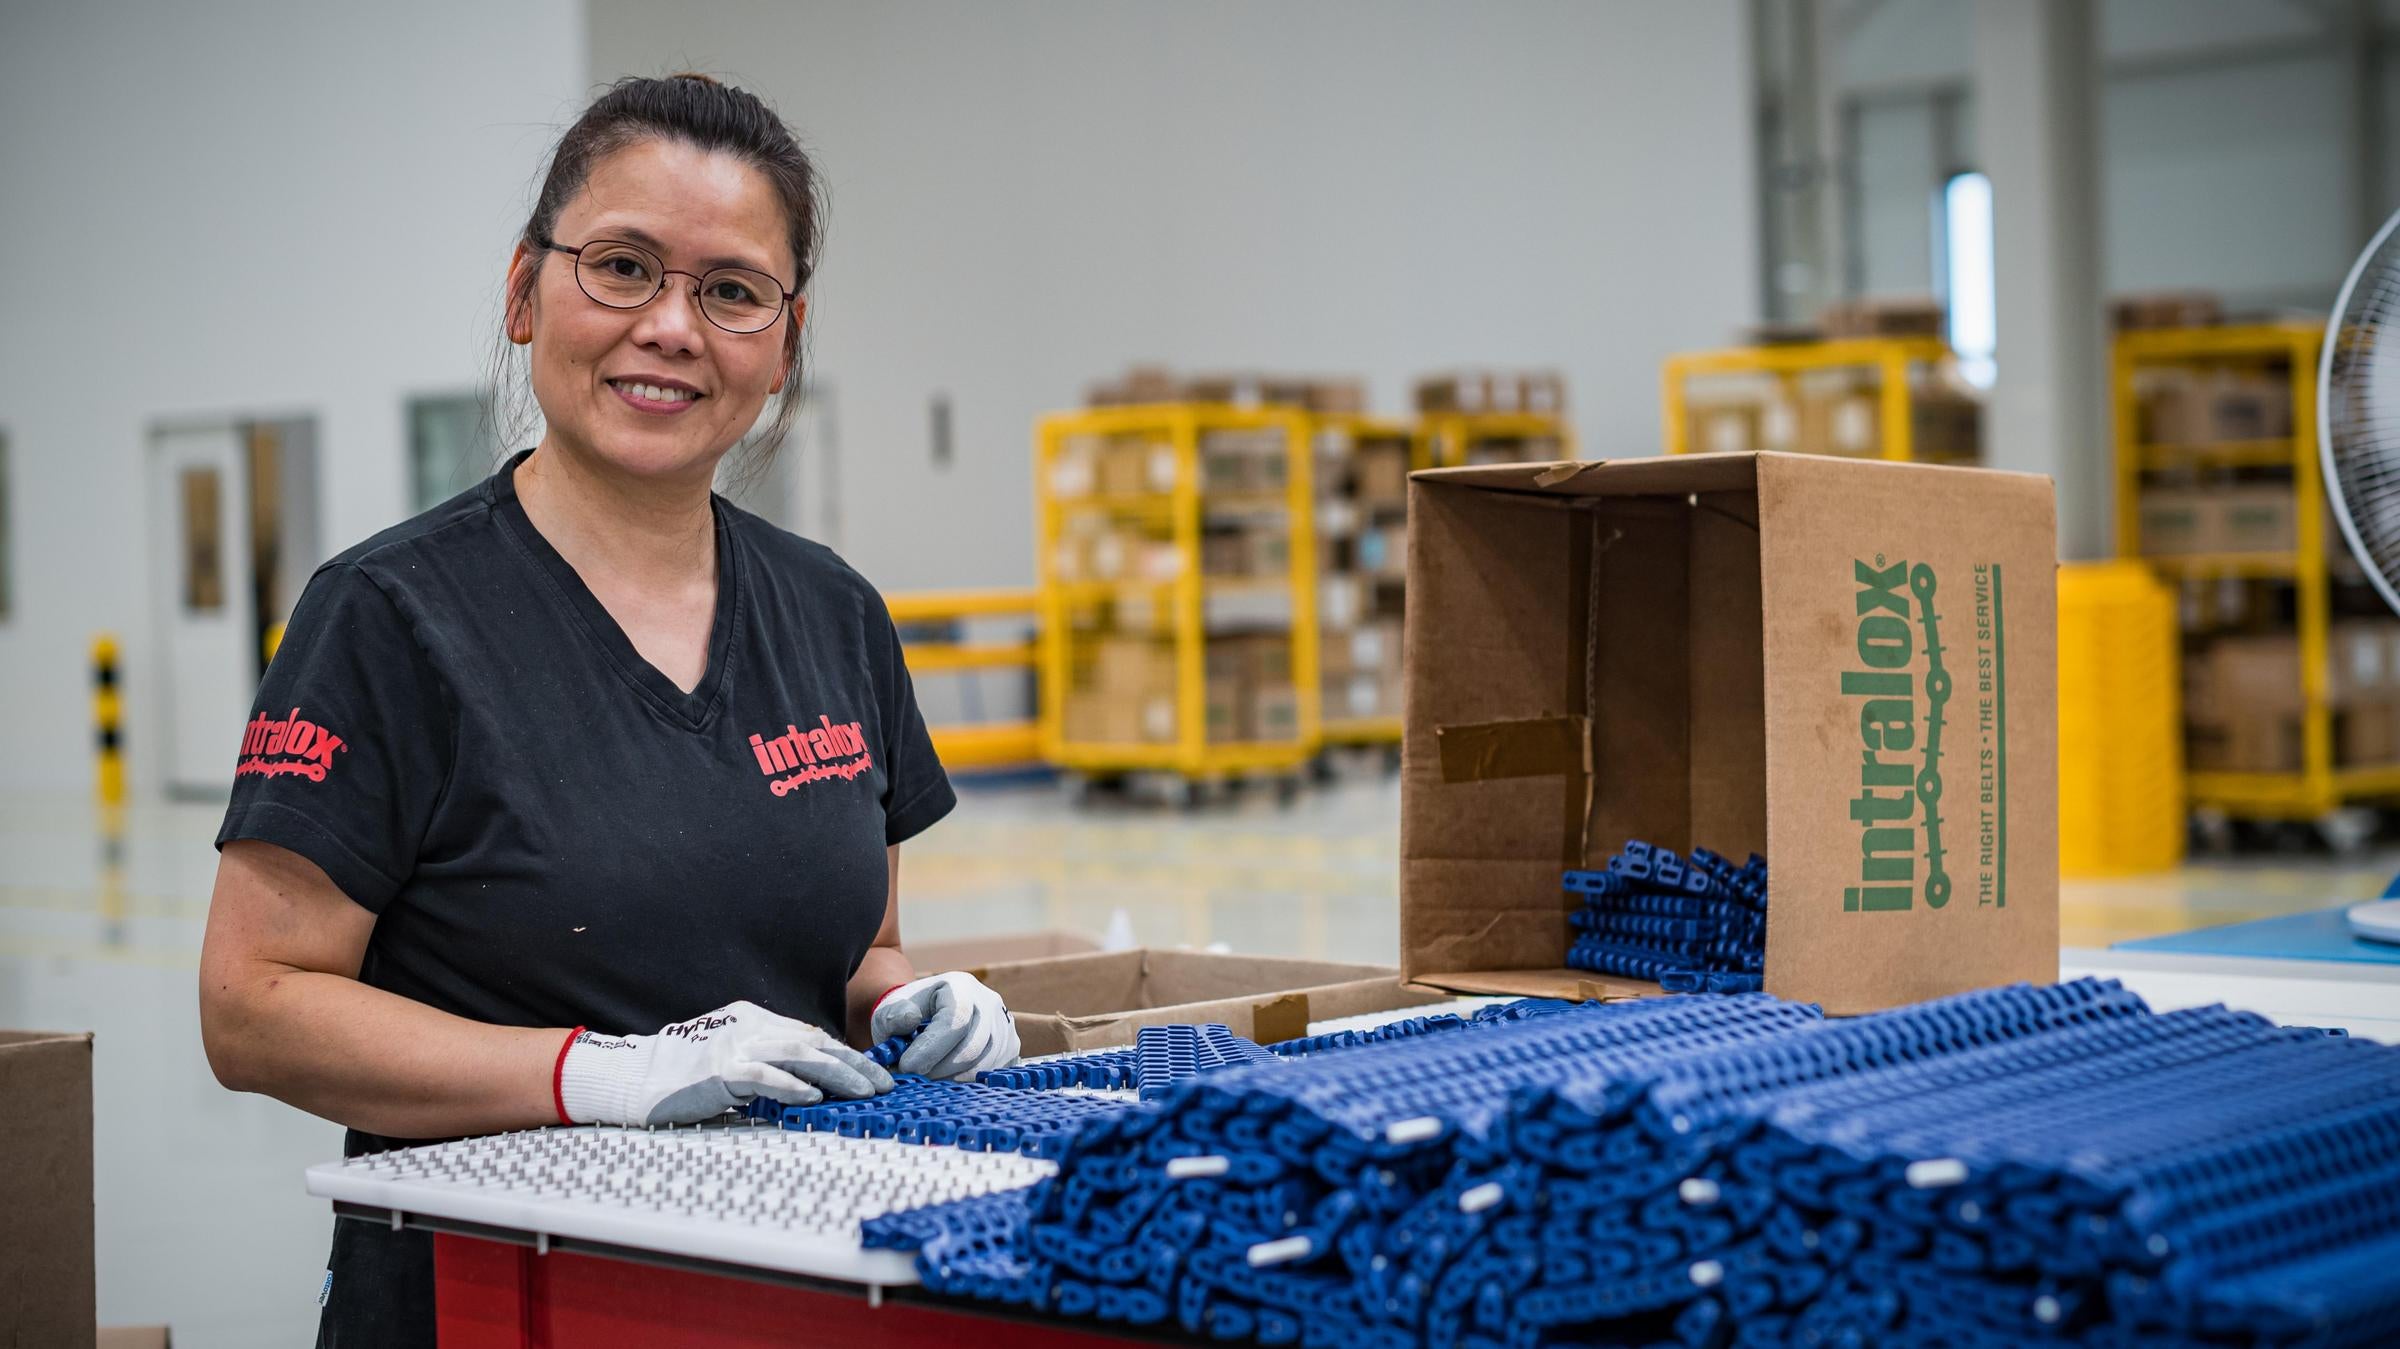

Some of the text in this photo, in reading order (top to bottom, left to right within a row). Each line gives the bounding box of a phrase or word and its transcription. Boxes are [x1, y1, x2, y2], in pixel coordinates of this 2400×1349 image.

[240, 707, 343, 770] ntralox
[1974, 563, 1994, 907] THE RIGHT BELTS THE BEST SERVICE
